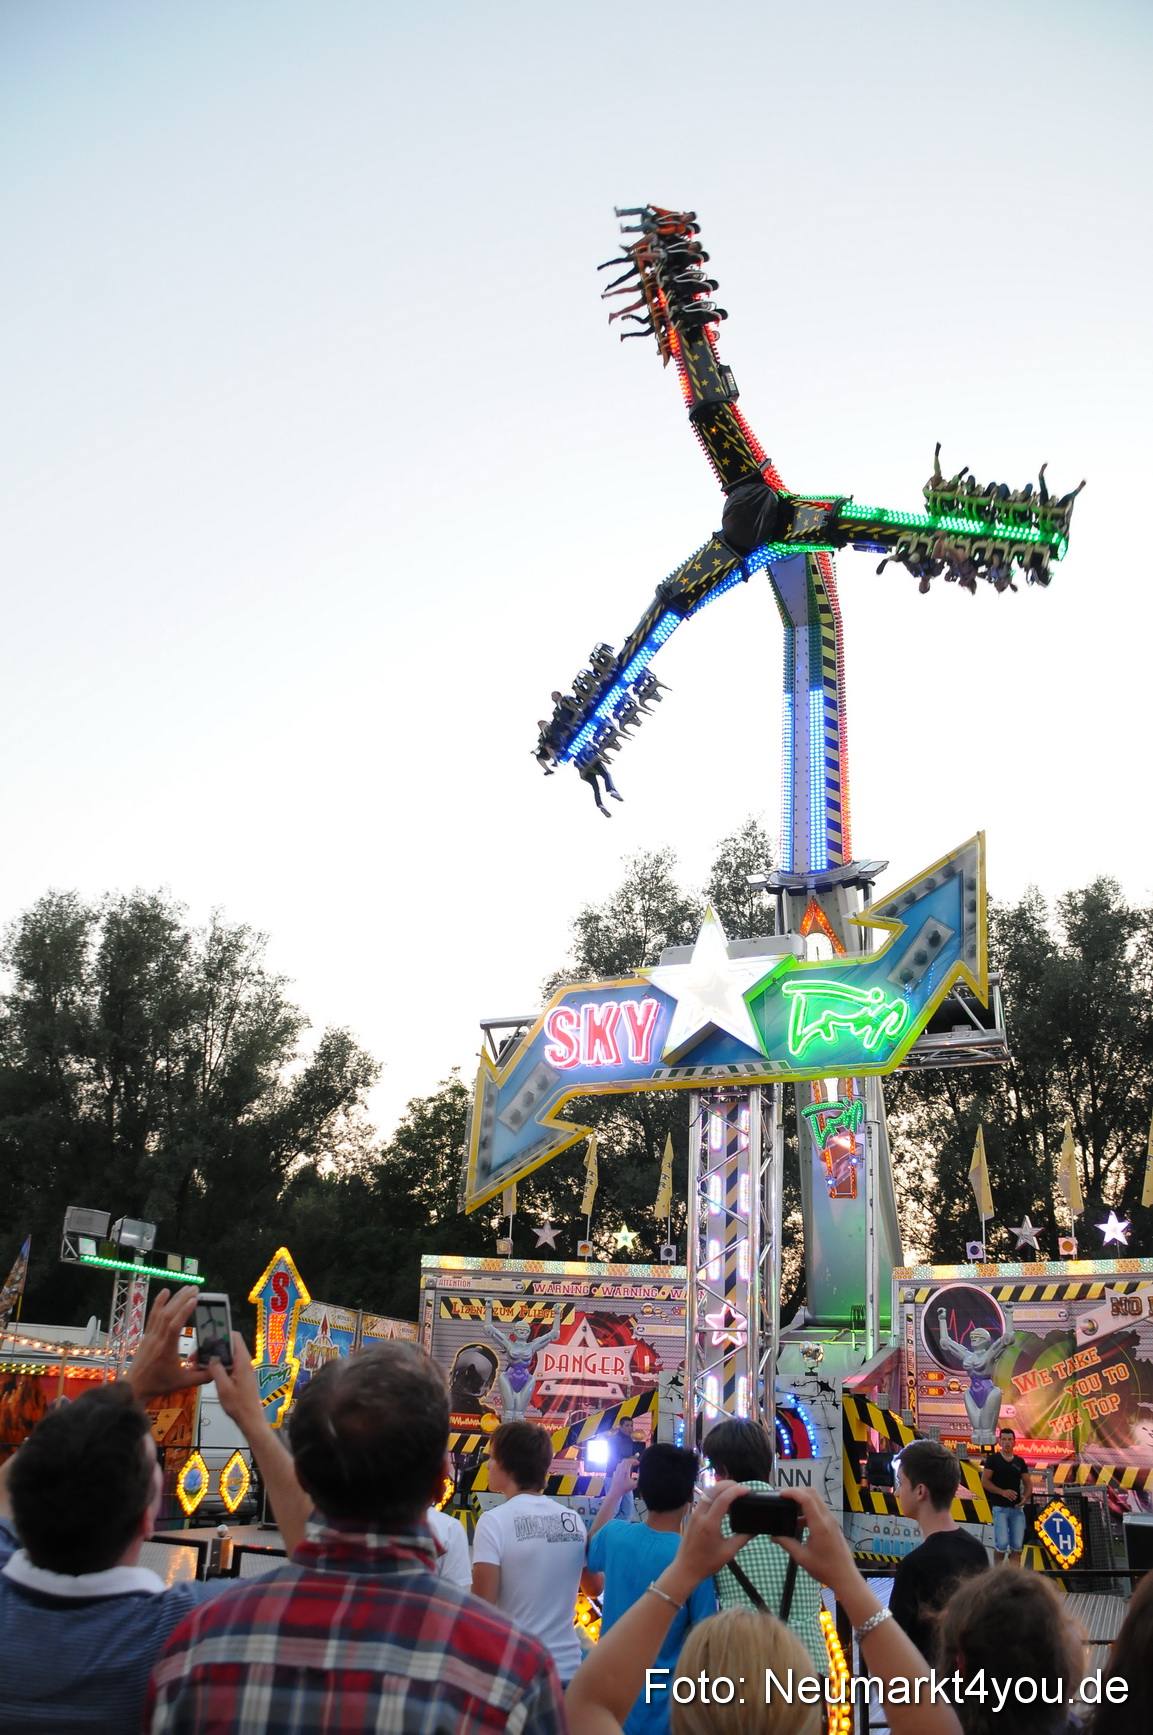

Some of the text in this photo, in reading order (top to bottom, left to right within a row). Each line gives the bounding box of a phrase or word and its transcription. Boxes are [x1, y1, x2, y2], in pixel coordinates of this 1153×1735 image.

[543, 998, 661, 1069] SKY
[782, 979, 907, 1056] Trip
[533, 1283, 590, 1296] WARNING
[601, 1286, 658, 1298] WARNING
[1110, 1296, 1143, 1317] NO
[544, 1352, 626, 1376] DANGER
[1011, 1347, 1101, 1395] WE TAKE
[1064, 1363, 1130, 1399] YOU TO
[1049, 1393, 1121, 1435] THE TOP
[777, 1467, 812, 1488] NN
